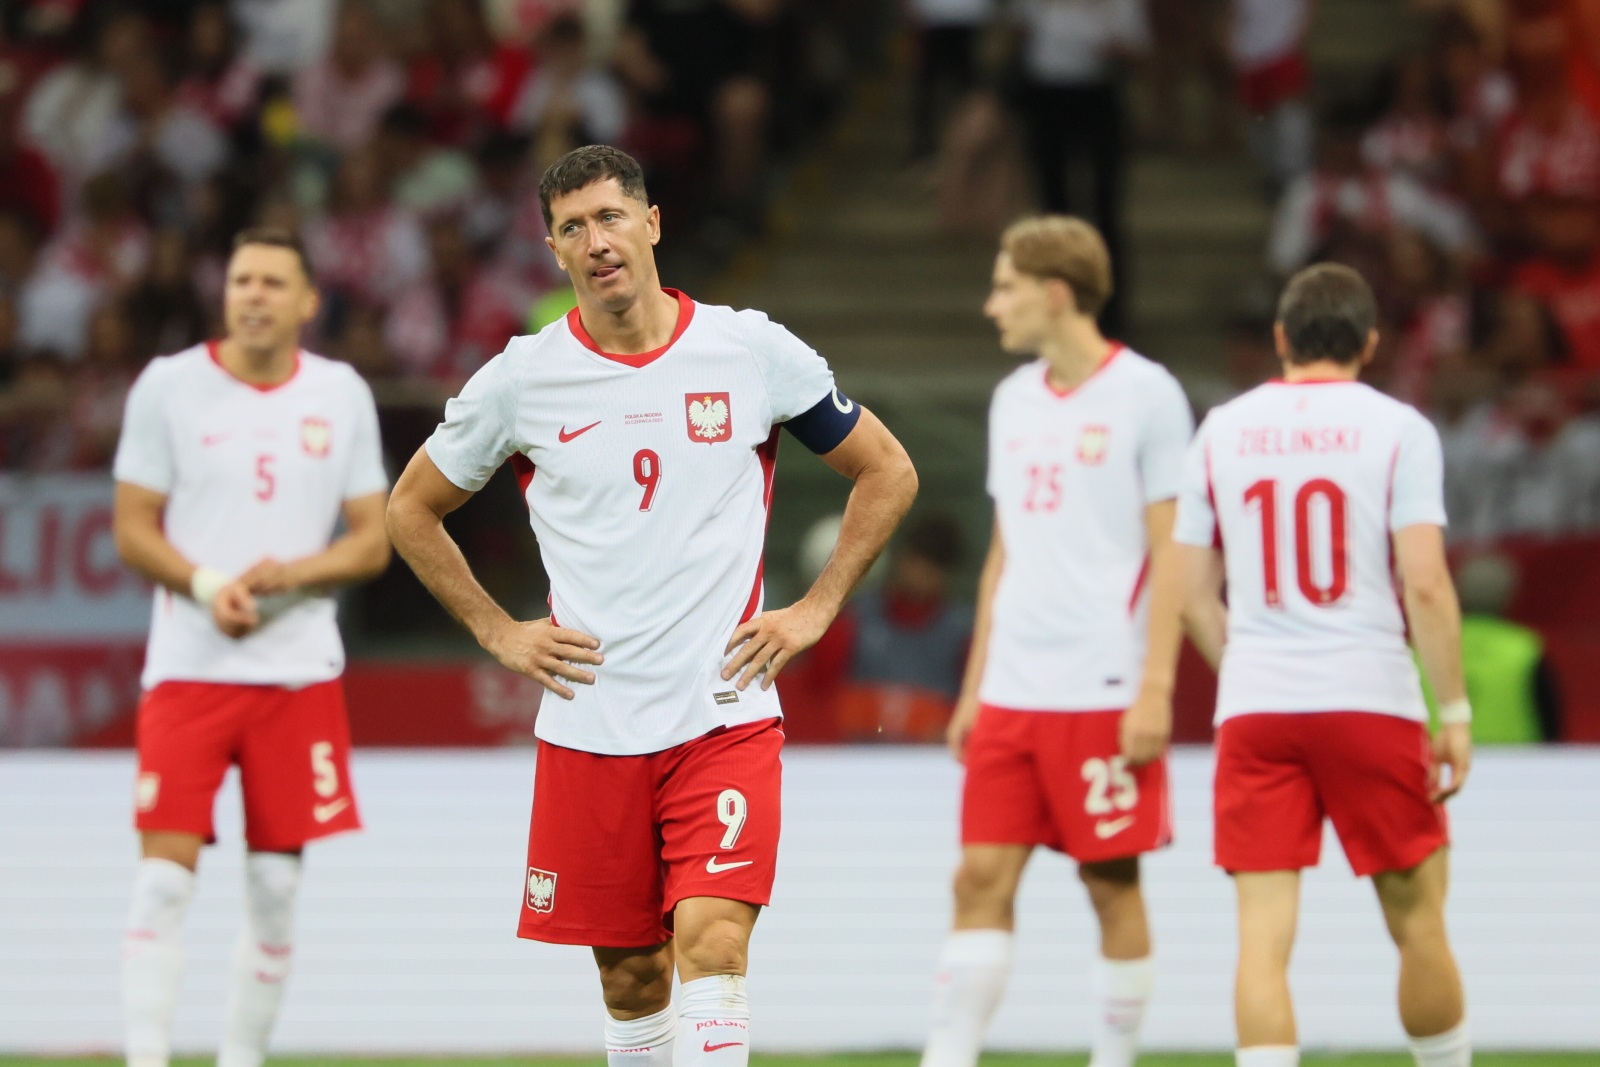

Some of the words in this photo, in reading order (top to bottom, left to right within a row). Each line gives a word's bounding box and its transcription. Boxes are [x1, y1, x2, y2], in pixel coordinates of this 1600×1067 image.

[255, 453, 276, 502] 5
[633, 449, 662, 512] 9
[1021, 464, 1064, 512] 25
[1244, 477, 1352, 611] 10
[310, 741, 339, 798] 5
[1081, 755, 1139, 815] 25
[717, 789, 747, 849] 9
